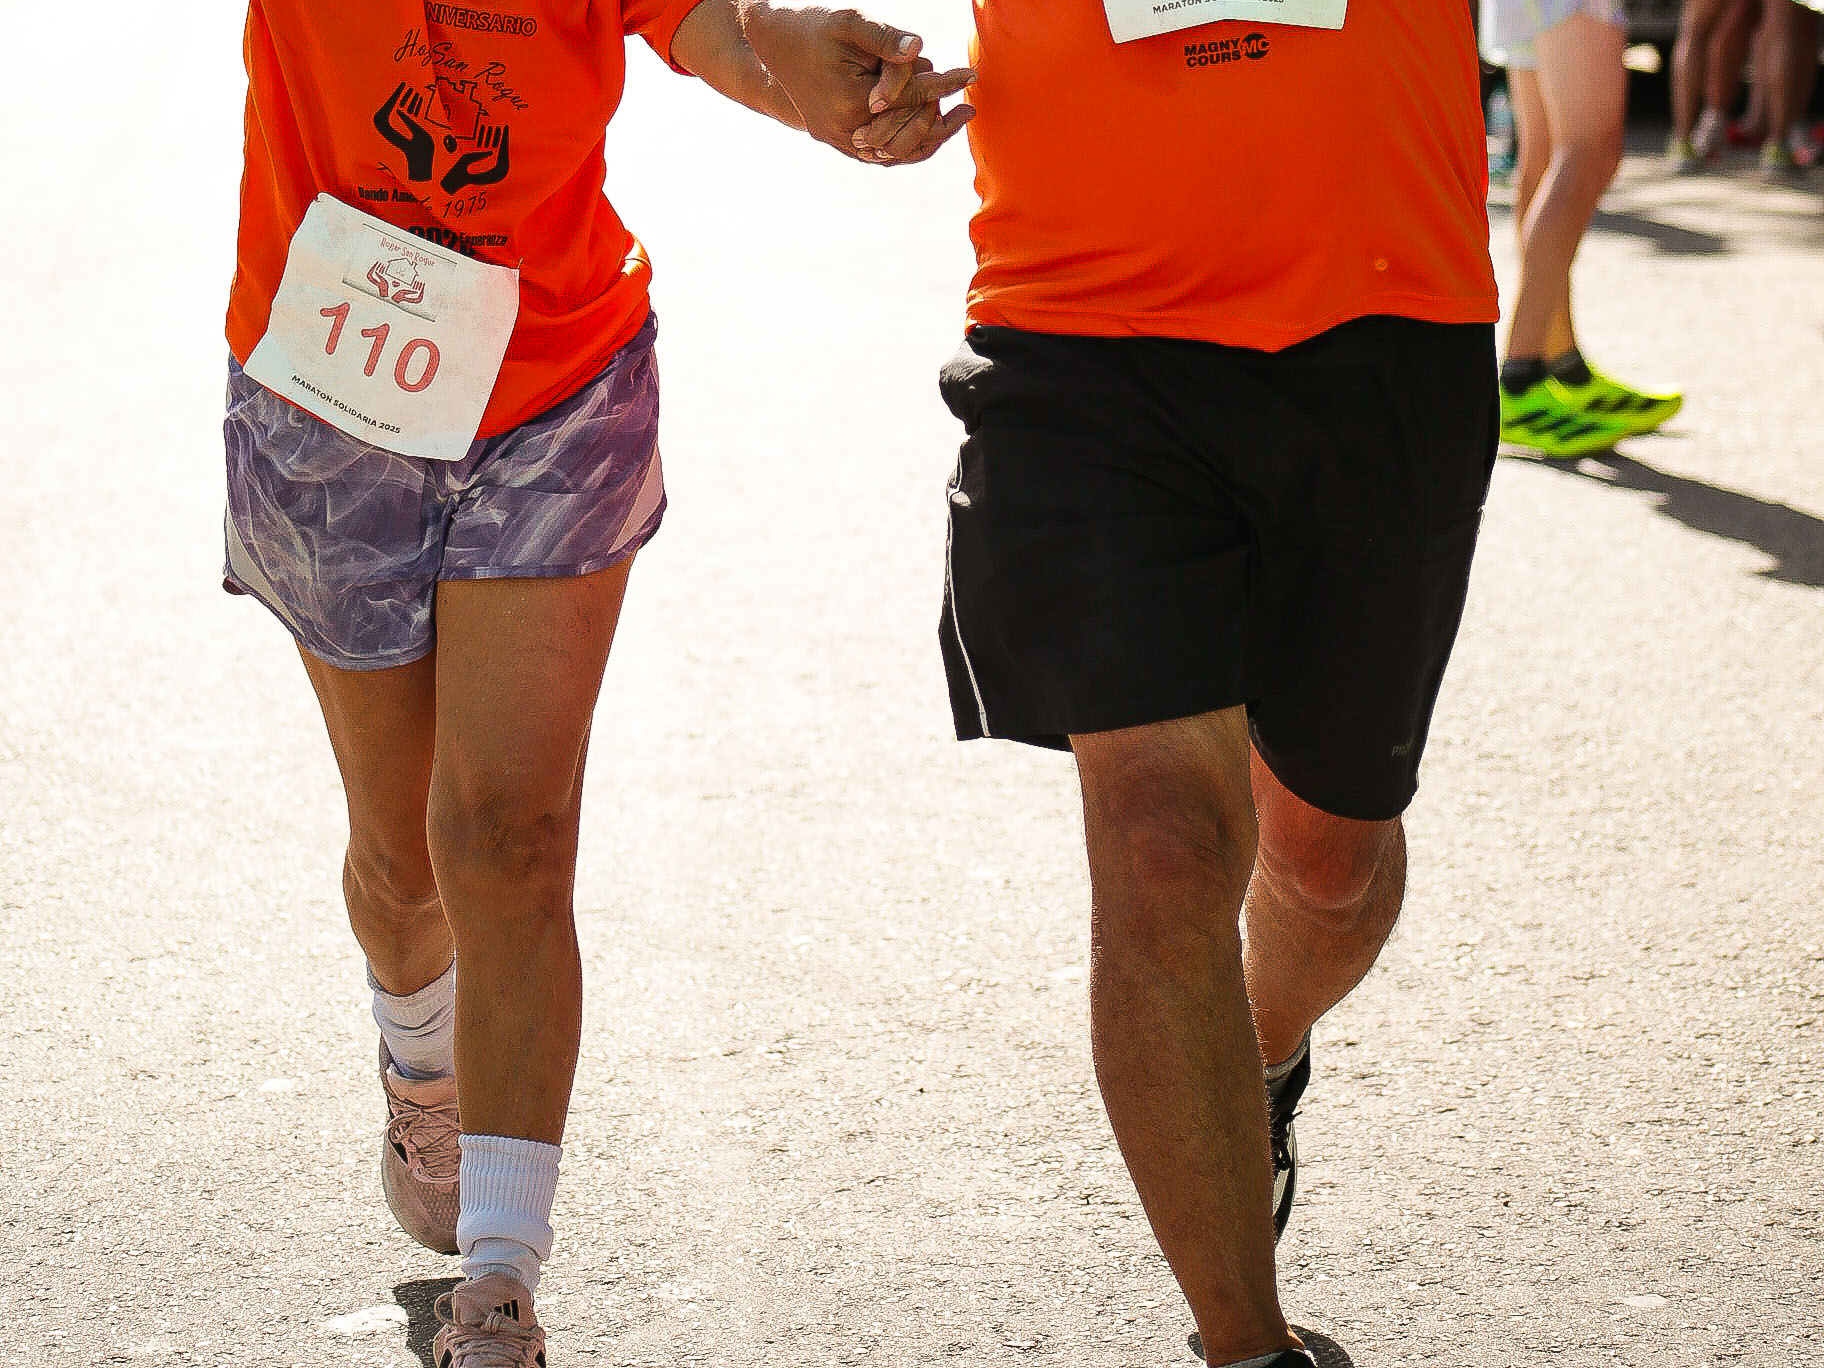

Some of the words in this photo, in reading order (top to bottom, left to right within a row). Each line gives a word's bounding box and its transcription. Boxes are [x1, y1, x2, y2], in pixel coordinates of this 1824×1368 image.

[424, 1, 537, 37] NIVERSARIO
[432, 42, 469, 72] San
[1184, 38, 1241, 56] MAGNY
[1186, 50, 1241, 68] COURS
[443, 192, 488, 229] 1975
[320, 302, 440, 392] 110
[291, 375, 333, 403] MARATON
[333, 399, 377, 427] SOLIDARIA
[378, 422, 401, 434] 2025
